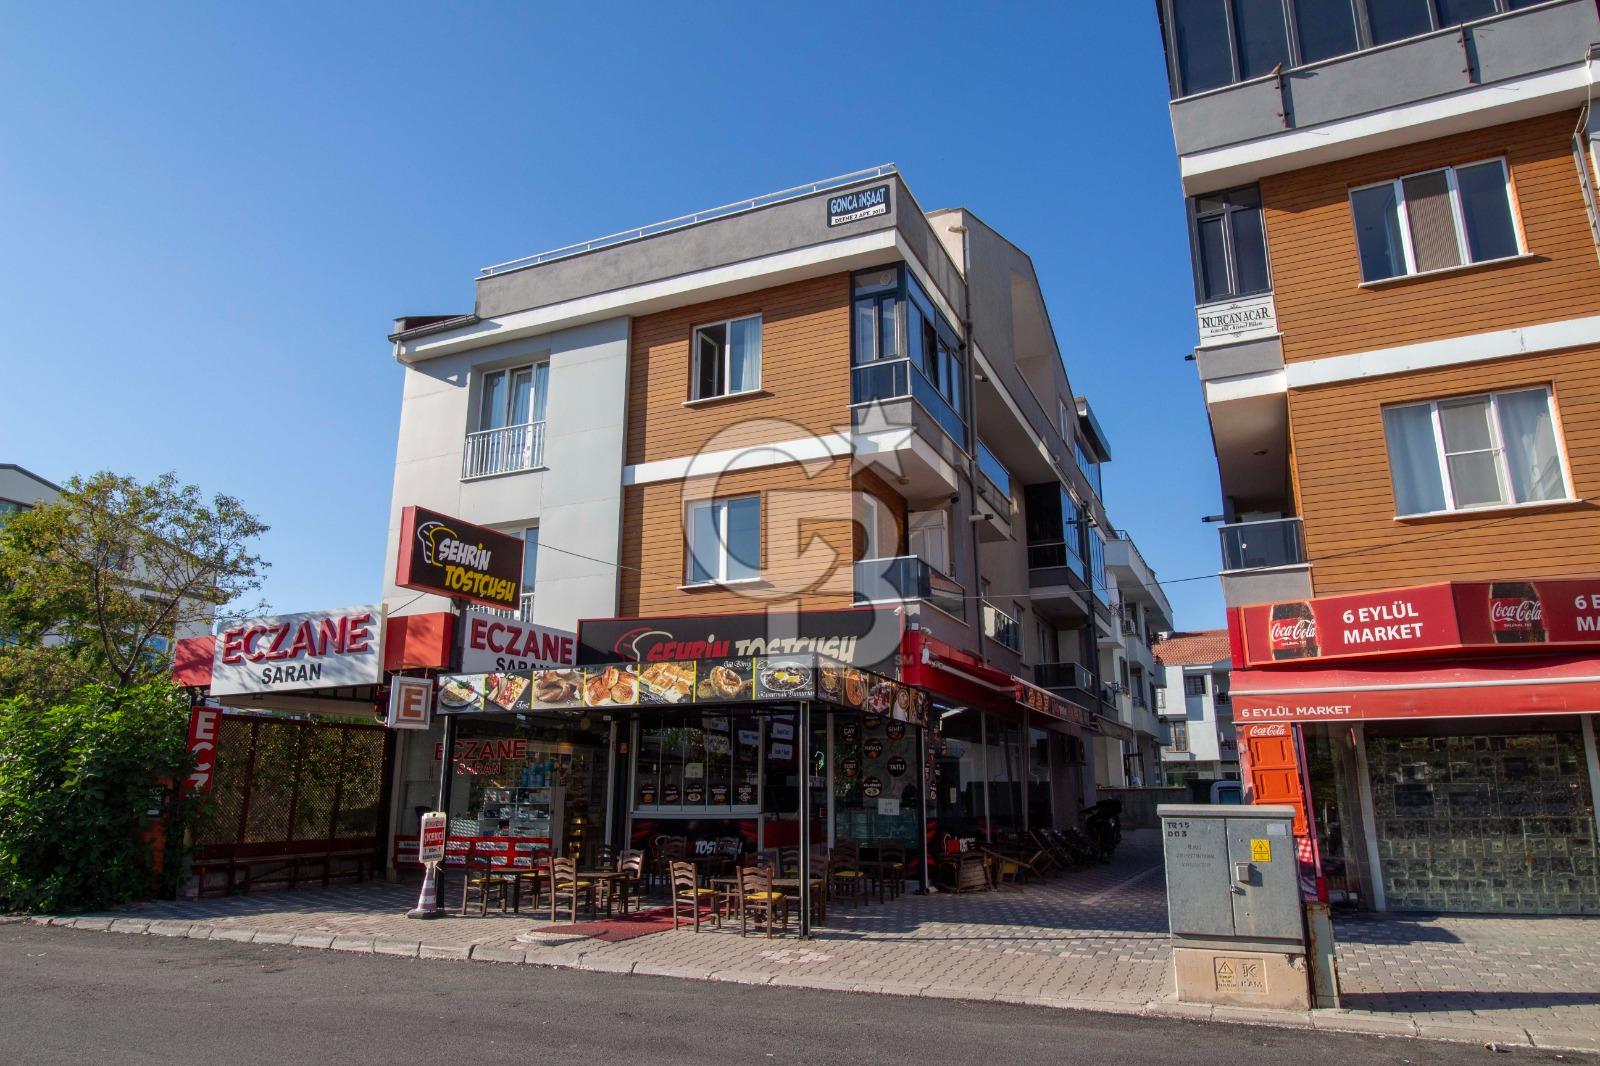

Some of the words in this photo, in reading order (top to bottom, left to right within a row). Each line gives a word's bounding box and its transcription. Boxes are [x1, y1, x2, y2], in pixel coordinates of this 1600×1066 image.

[830, 194, 858, 214] GONCA
[1242, 306, 1270, 322] ACAR
[438, 537, 492, 572] ŞEHRİN
[444, 565, 516, 602] TOSTÇUSU
[1342, 610, 1355, 624] 6
[1358, 600, 1419, 623] EYLÜL
[1492, 600, 1543, 622] Coca-Cola
[1574, 595, 1588, 610] 6
[221, 613, 372, 665] ECZANE
[1271, 618, 1316, 642] Coca-Cola
[1343, 622, 1424, 645] MARKET
[470, 618, 574, 666] ECZANE
[261, 662, 322, 685] SARAN
[404, 688, 424, 718] E
[1242, 708, 1250, 718] 6
[1252, 706, 1294, 717] EYLÜL
[1296, 704, 1352, 716] MARKET
[1250, 724, 1287, 737] Coca-Cola
